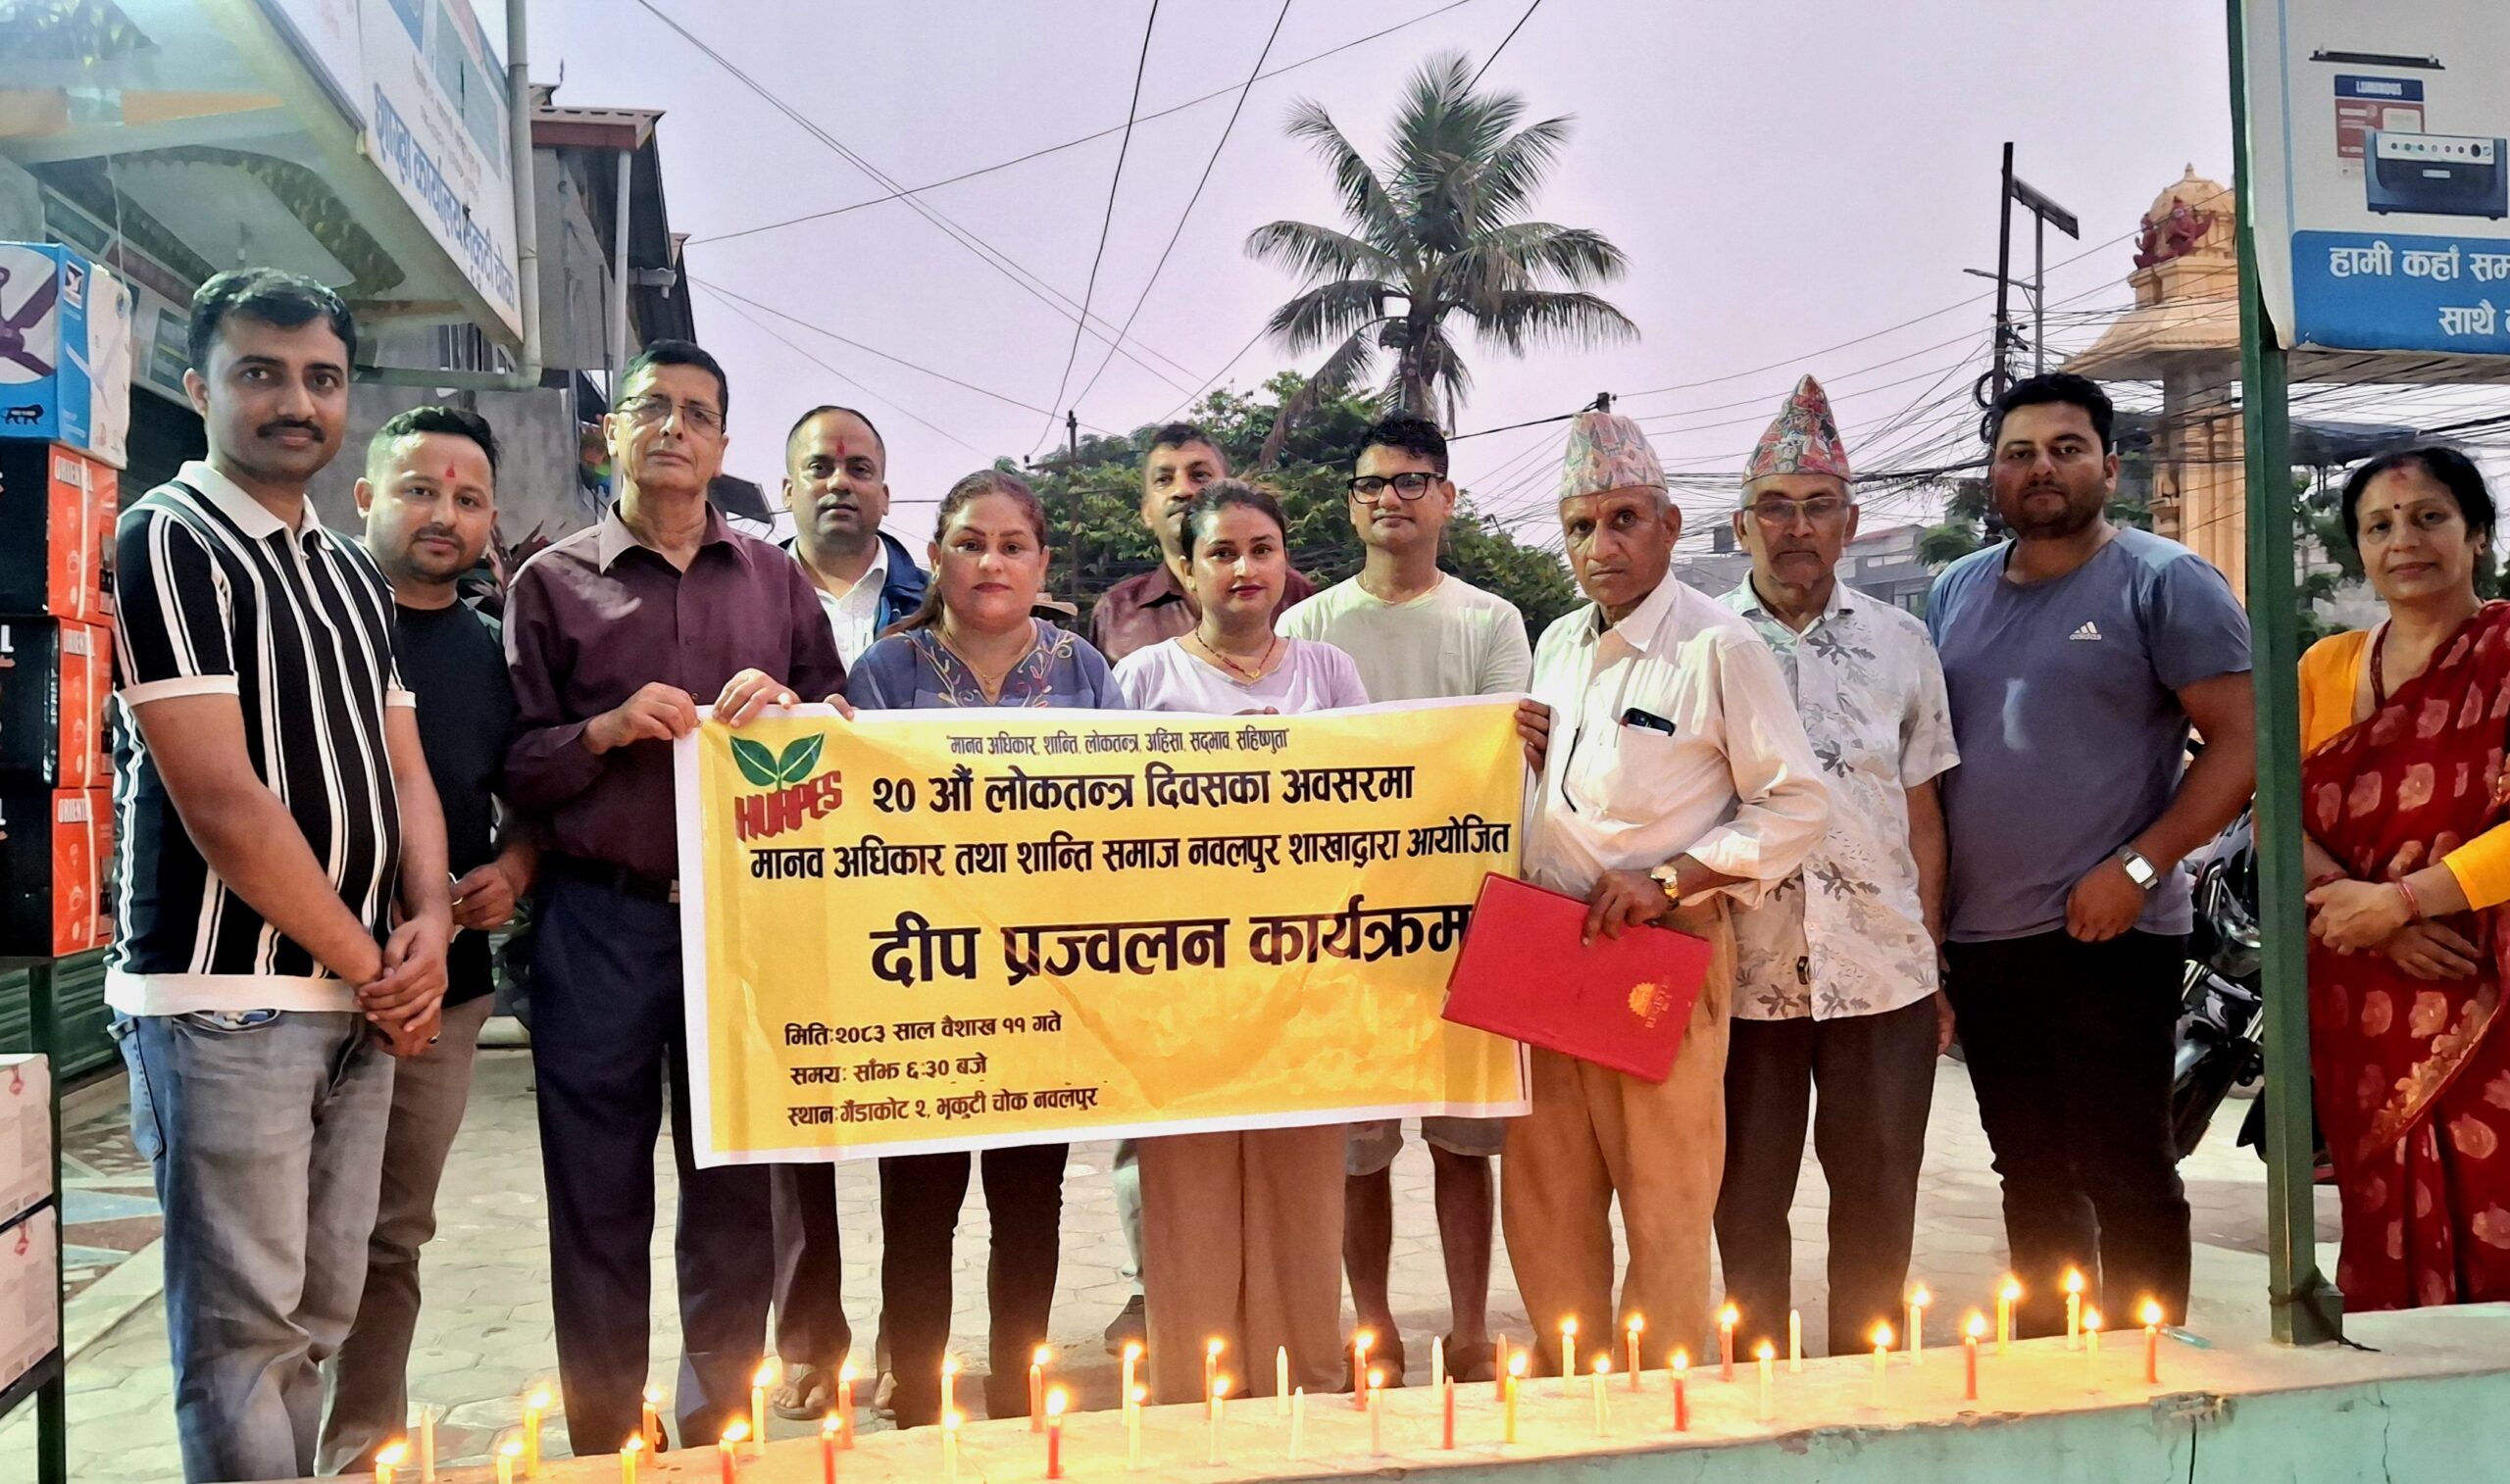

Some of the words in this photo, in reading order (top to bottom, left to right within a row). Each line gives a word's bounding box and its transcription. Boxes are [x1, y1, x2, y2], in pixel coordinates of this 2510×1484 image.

[374, 82, 411, 184] शाखा
[411, 136, 463, 246] कार्यालय
[2329, 239, 2393, 278] हामी
[2438, 298, 2496, 336] साथै
[873, 777, 916, 813] २०
[984, 765, 1134, 813] लोकतन्त्र
[1145, 761, 1271, 810] दिवसका
[1281, 766, 1415, 804] अवसरमा
[750, 848, 825, 879] मानव
[833, 834, 945, 878] अधिकार
[955, 842, 1008, 876] तथा
[1016, 829, 1094, 873] शान्ति
[1102, 837, 1180, 872] समाज
[1187, 834, 1280, 873] नवलपुर
[1288, 829, 1400, 868] शाखाद्वारा
[1406, 814, 1511, 858] आयोजित
[869, 911, 981, 988] दीप
[1000, 917, 1230, 986] प्रज्वलन
[1248, 894, 1474, 965] कार्यक्रम
[892, 1021, 935, 1041] साल
[941, 1014, 997, 1038] वैशाख
[1002, 1016, 1026, 1034] ११
[1032, 1010, 1062, 1032] गते
[956, 1052, 988, 1074] बजे
[936, 1090, 986, 1120] भृकुटी
[992, 1088, 1029, 1112] चोक
